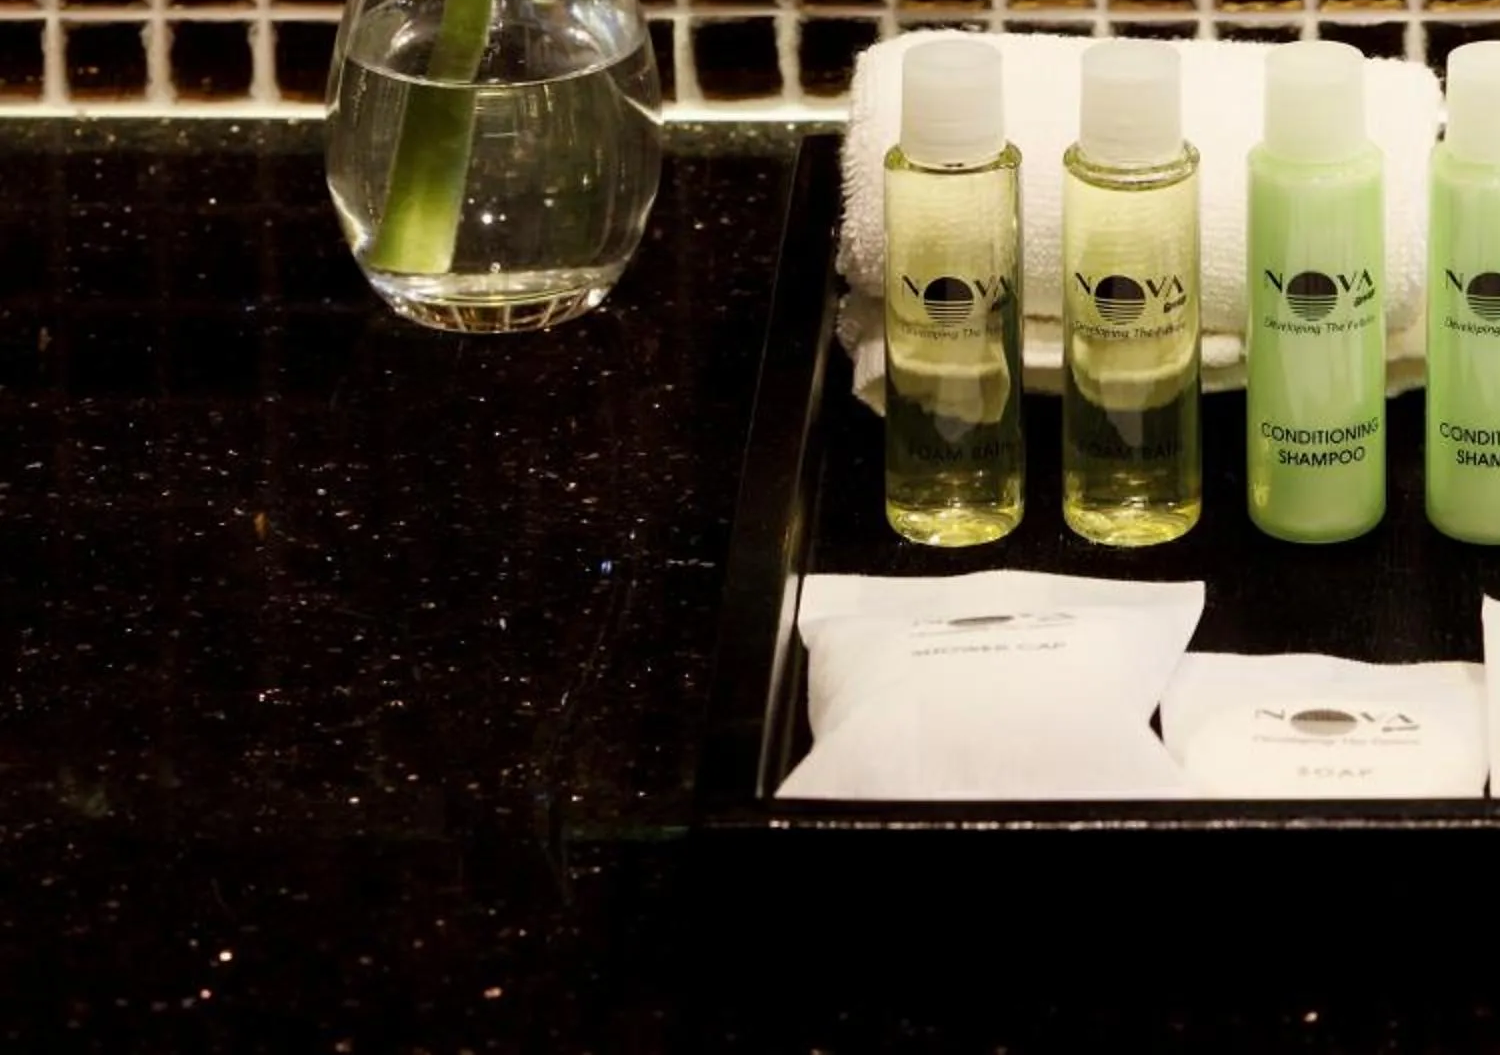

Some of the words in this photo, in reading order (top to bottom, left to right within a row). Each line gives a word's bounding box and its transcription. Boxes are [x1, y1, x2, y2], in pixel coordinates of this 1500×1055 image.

[1075, 272, 1186, 326] NOVA
[1264, 268, 1374, 322] NOVA
[1261, 417, 1380, 445] CONDITIONING
[1278, 447, 1366, 467] SHAMPOO
